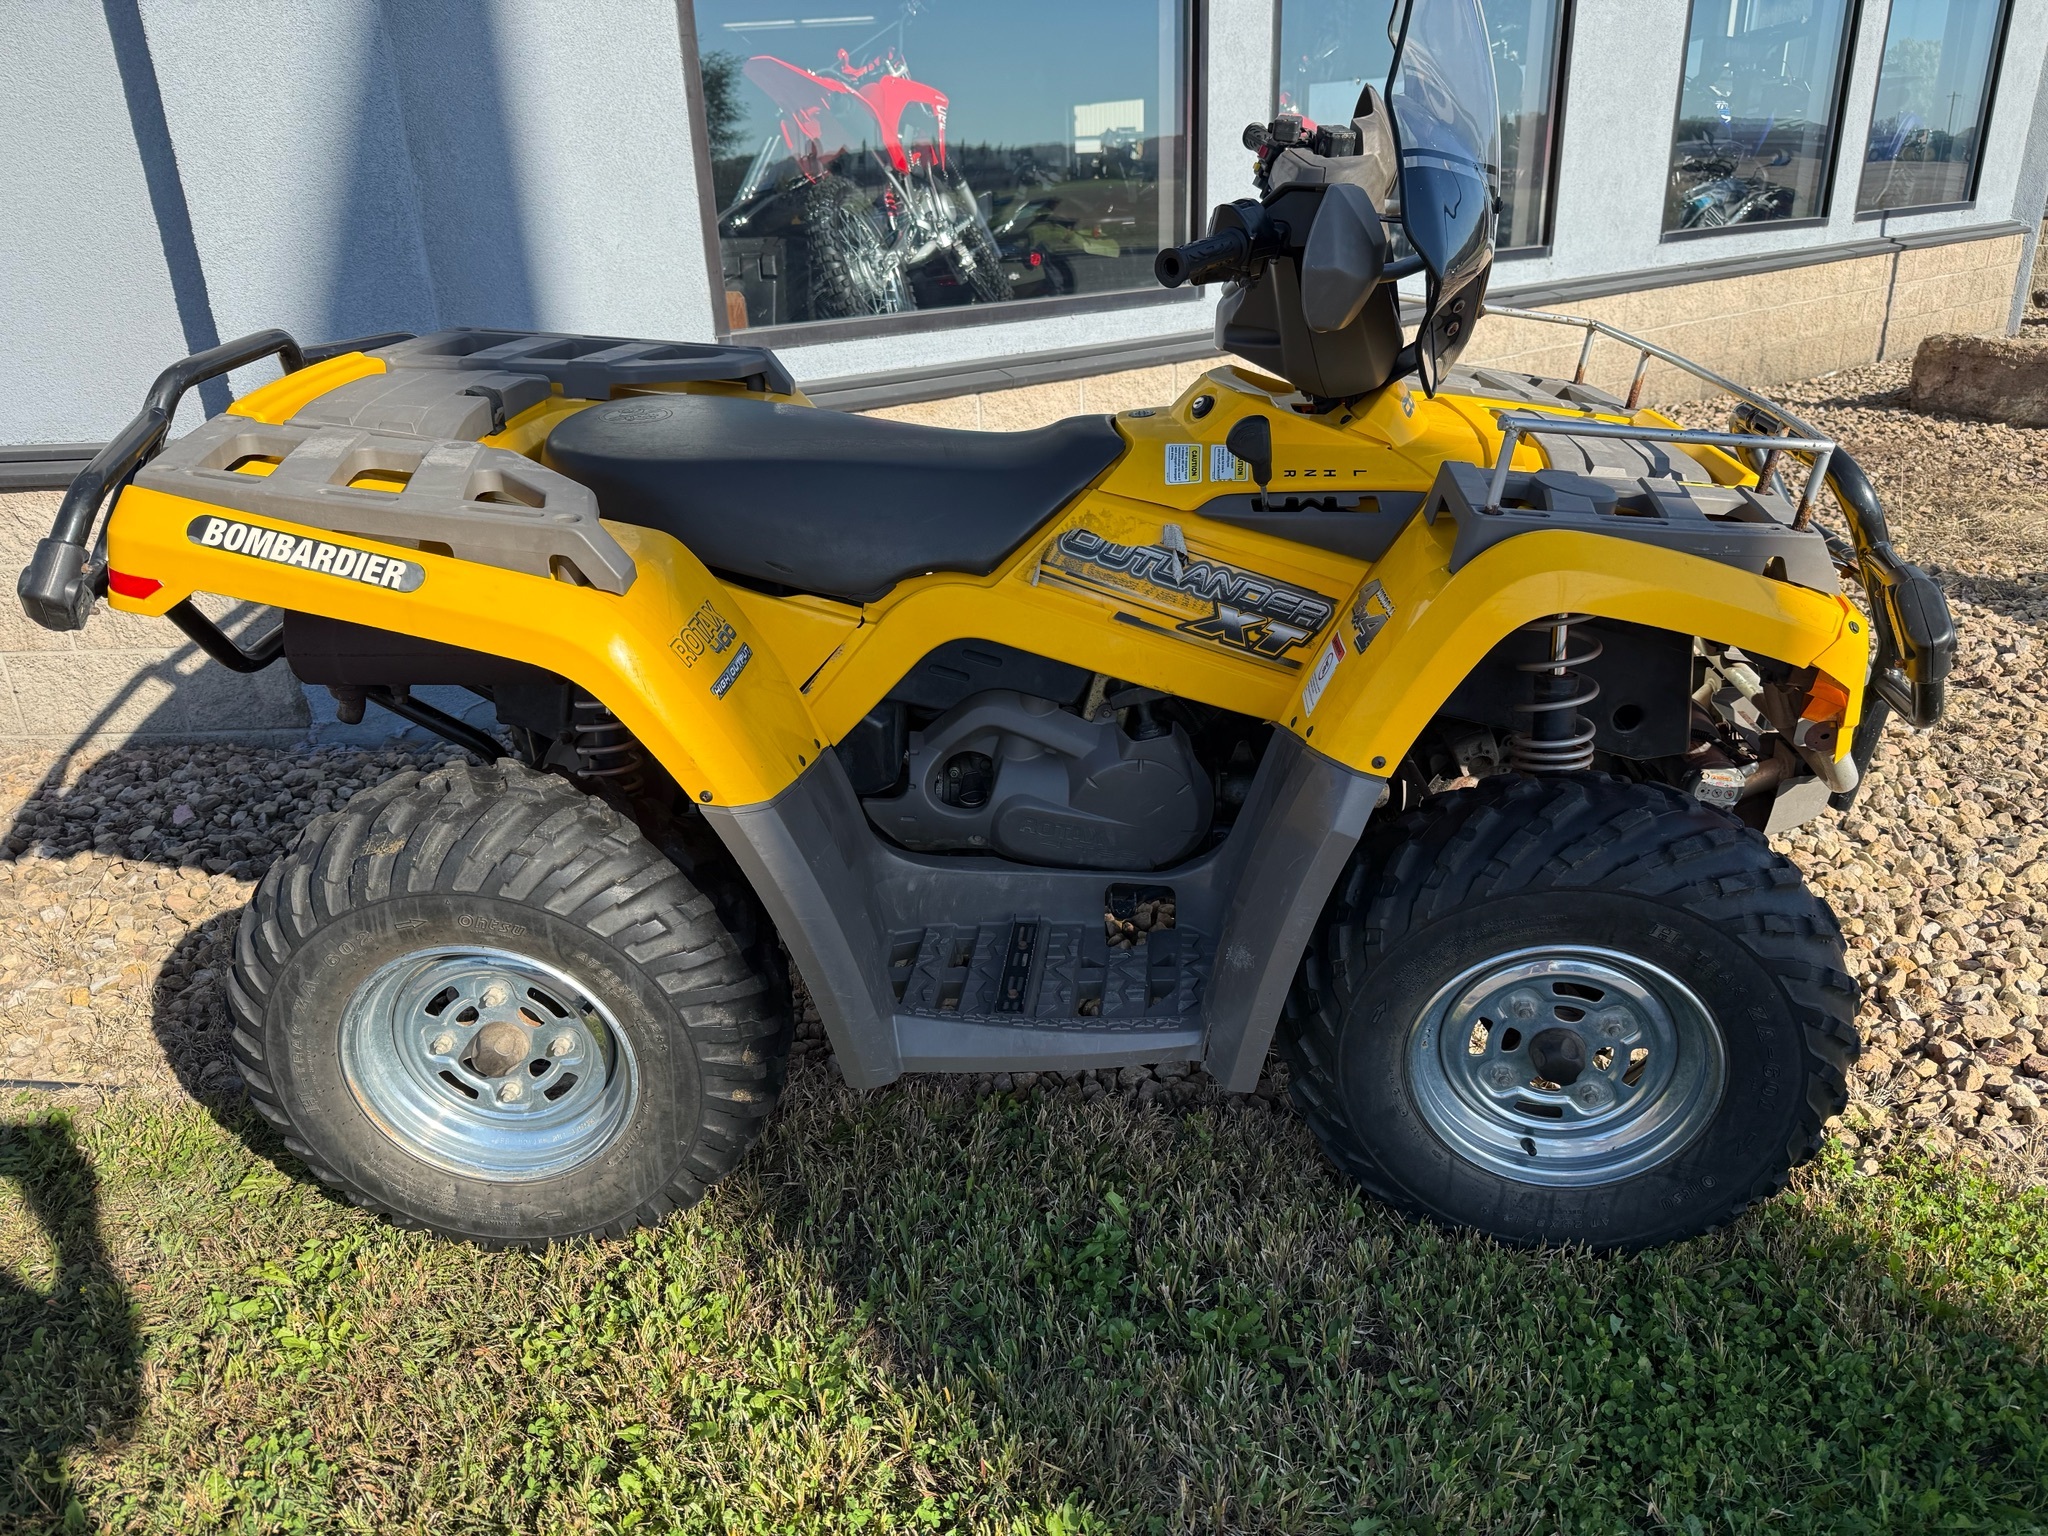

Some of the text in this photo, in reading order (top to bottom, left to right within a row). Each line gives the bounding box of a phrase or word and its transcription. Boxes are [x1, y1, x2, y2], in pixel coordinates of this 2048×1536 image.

[1283, 469, 1297, 478] R
[1304, 469, 1317, 477] N
[1323, 469, 1336, 477] H
[1353, 469, 1367, 477] L
[200, 517, 407, 590] BOMBARDIER
[1059, 528, 1333, 630] OUTLANDER
[669, 599, 727, 669] ROTAX
[1188, 602, 1313, 658] XT
[712, 645, 751, 696] HIGH OUTPUT
[456, 914, 527, 938] Ohtsu
[295, 930, 373, 1015] ZA-602
